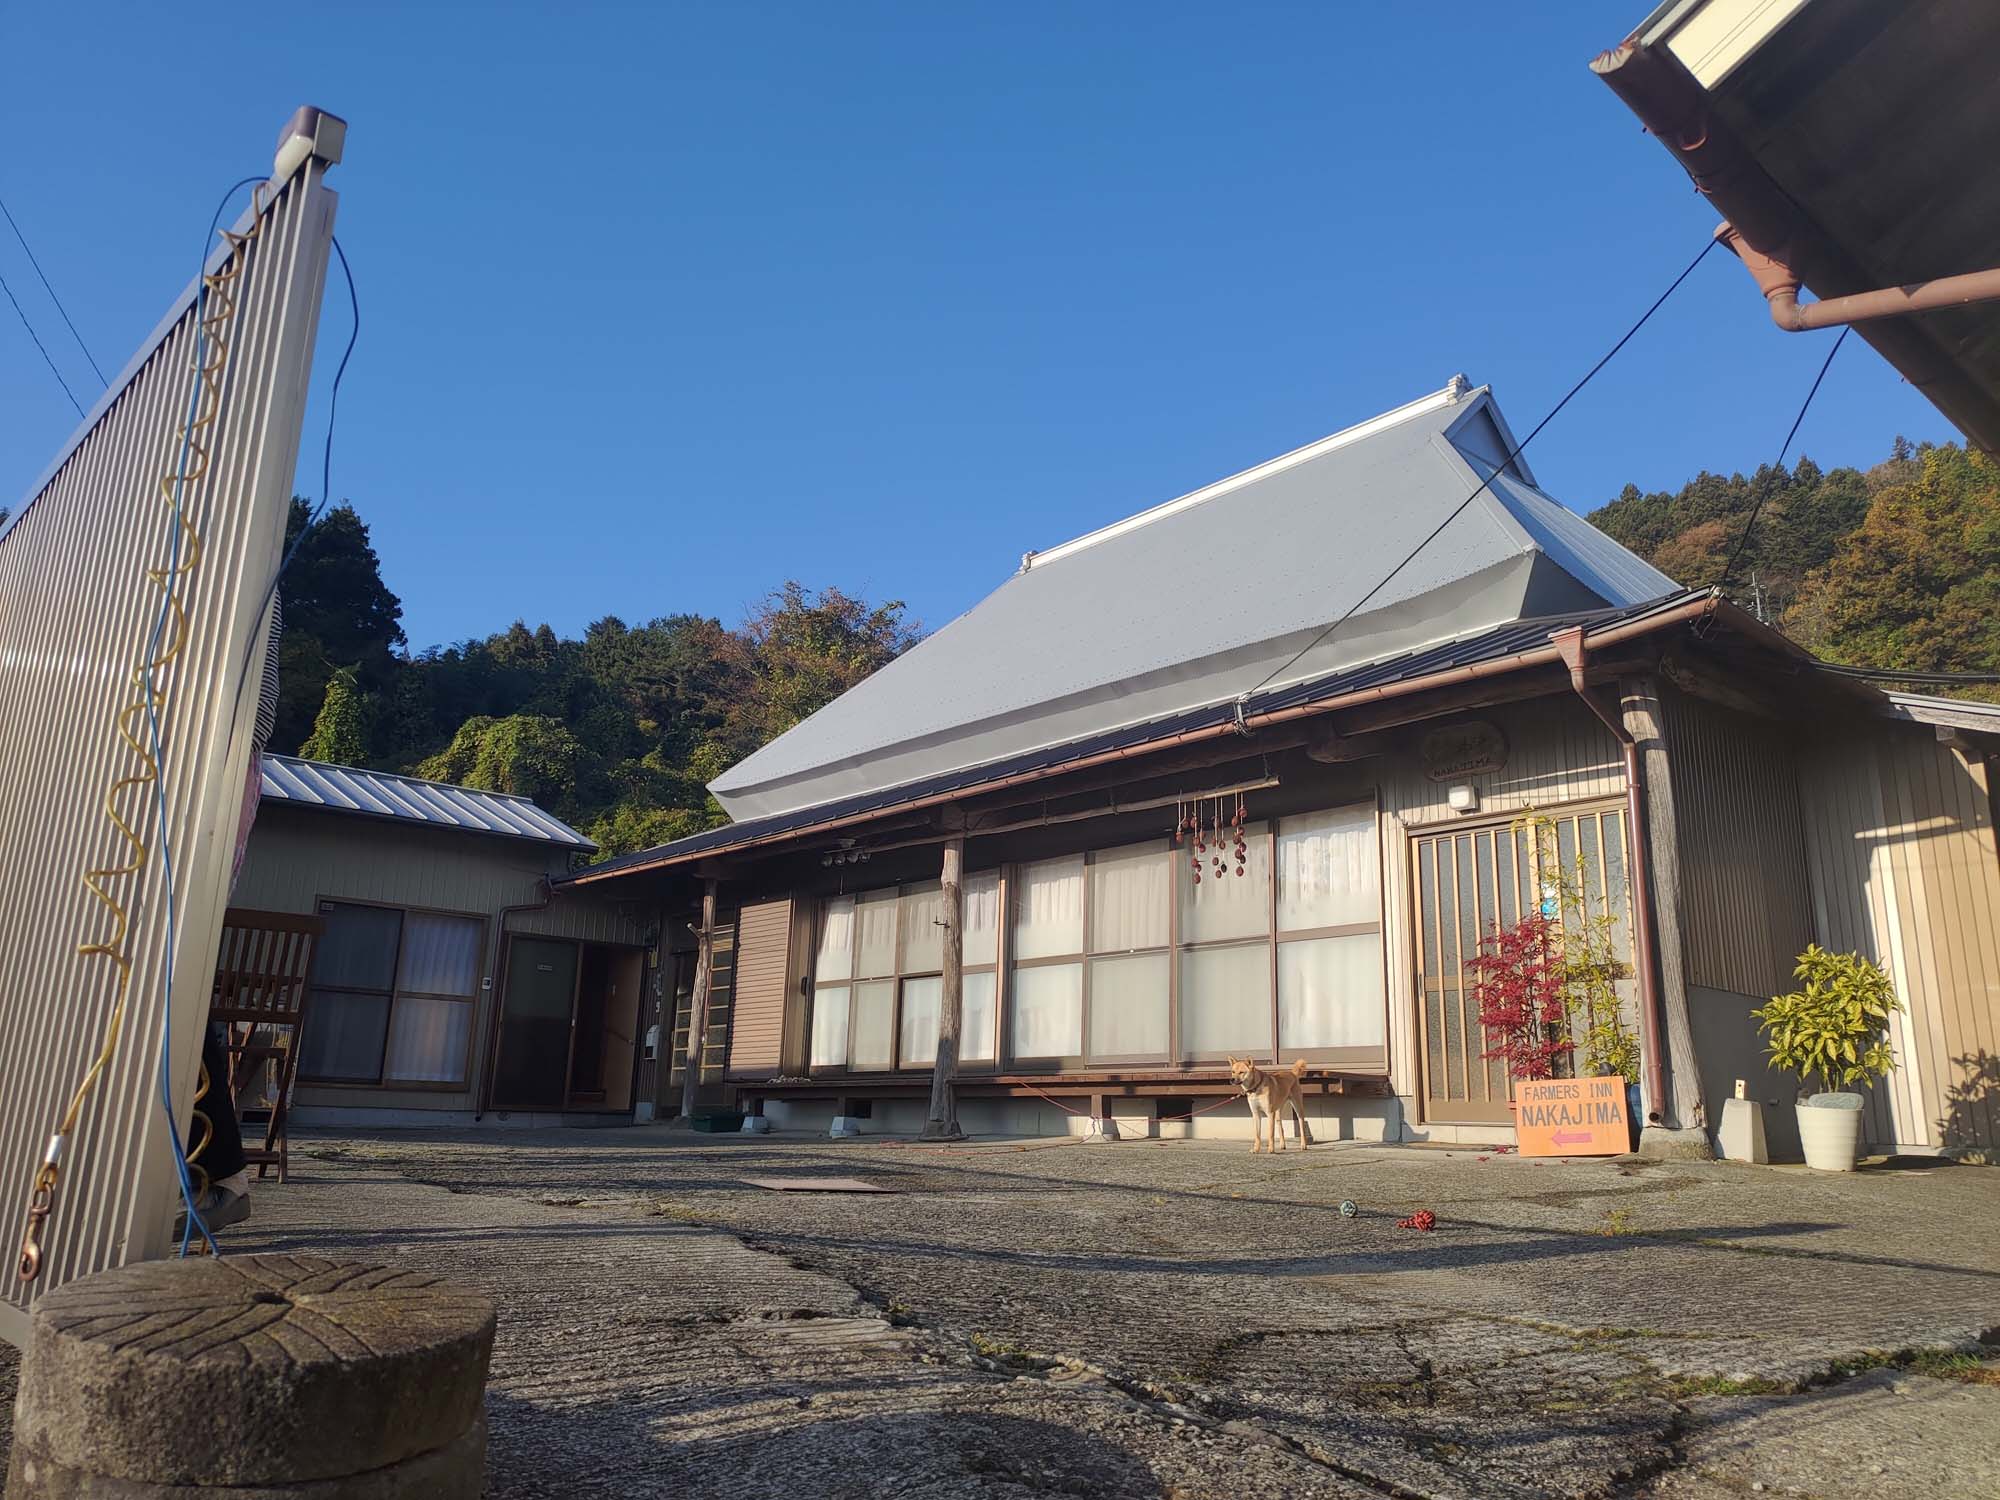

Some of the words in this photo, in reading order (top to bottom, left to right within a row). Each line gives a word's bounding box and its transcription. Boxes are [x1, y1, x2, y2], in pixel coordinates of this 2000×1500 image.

[1524, 1085, 1580, 1101] FARMERS
[1590, 1083, 1612, 1098] INN
[1522, 1102, 1622, 1127] NAKAJIMA
